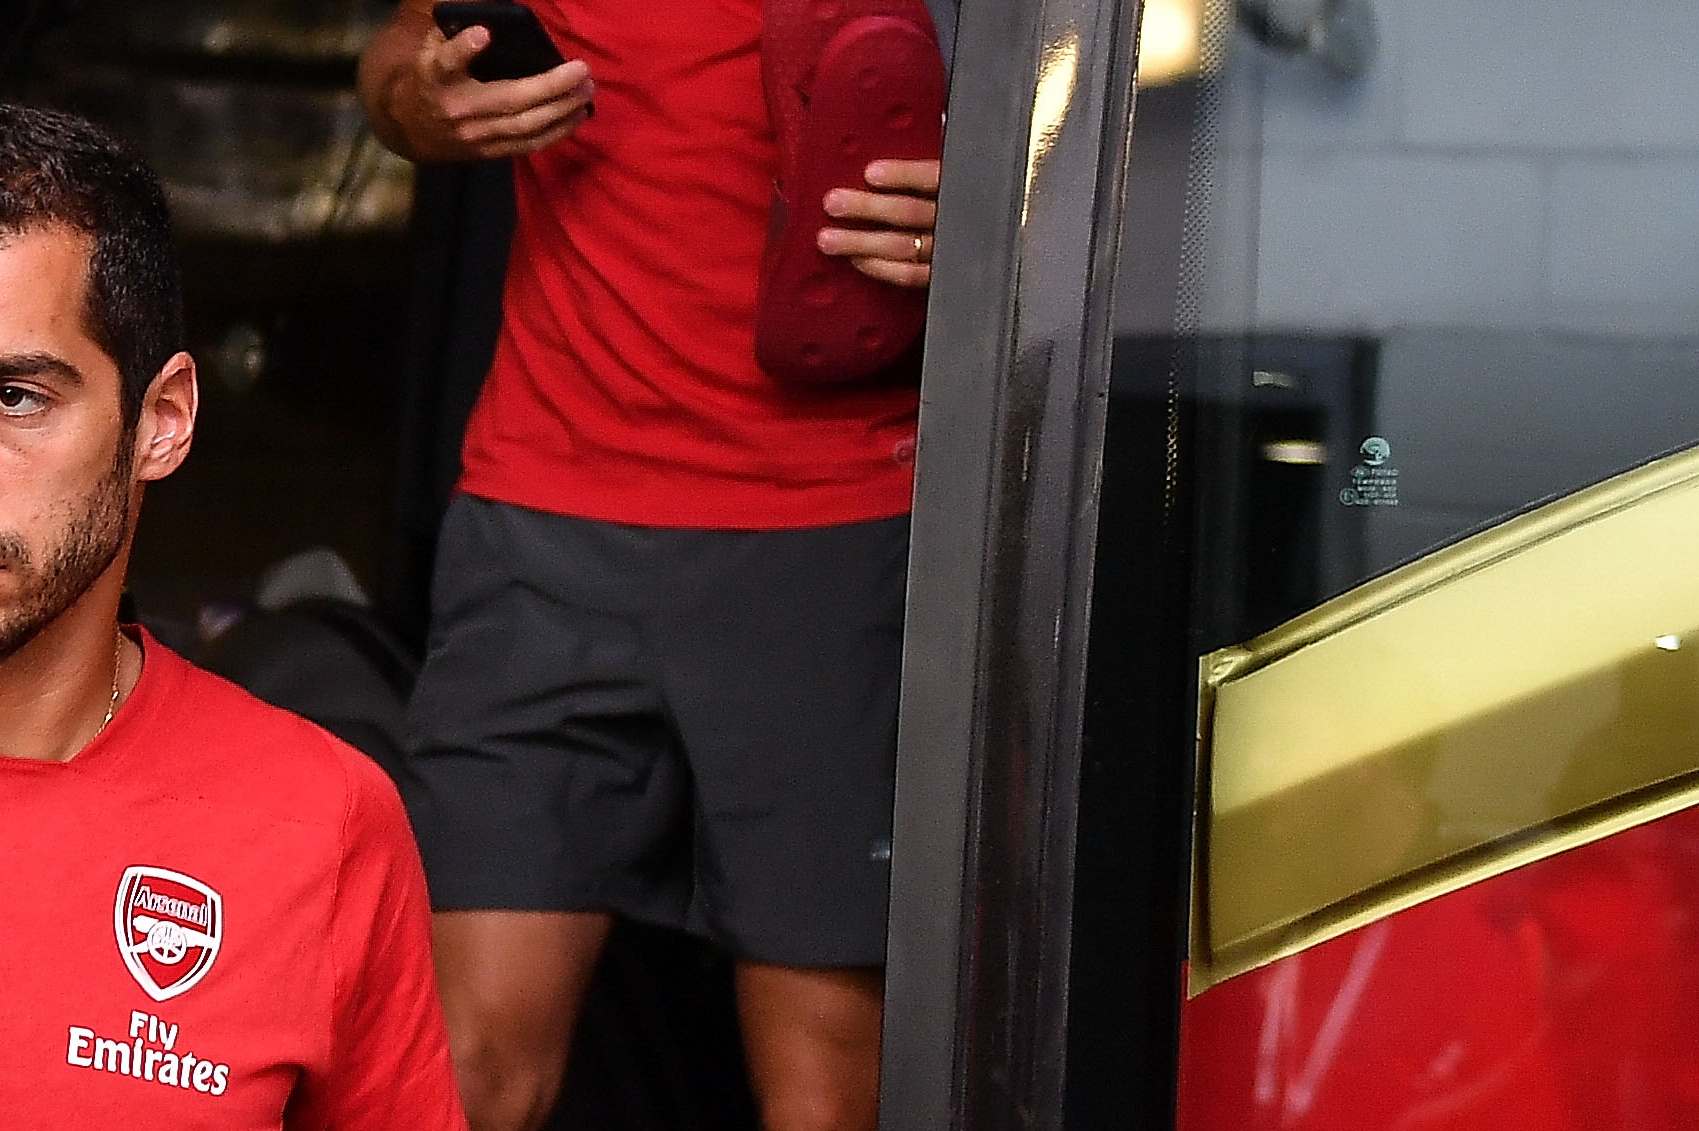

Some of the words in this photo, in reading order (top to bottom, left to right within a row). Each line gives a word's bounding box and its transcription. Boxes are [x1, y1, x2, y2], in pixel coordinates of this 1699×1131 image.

[135, 886, 208, 926] Arsenal
[130, 1011, 179, 1051] Fly
[67, 1026, 229, 1096] Emirates
